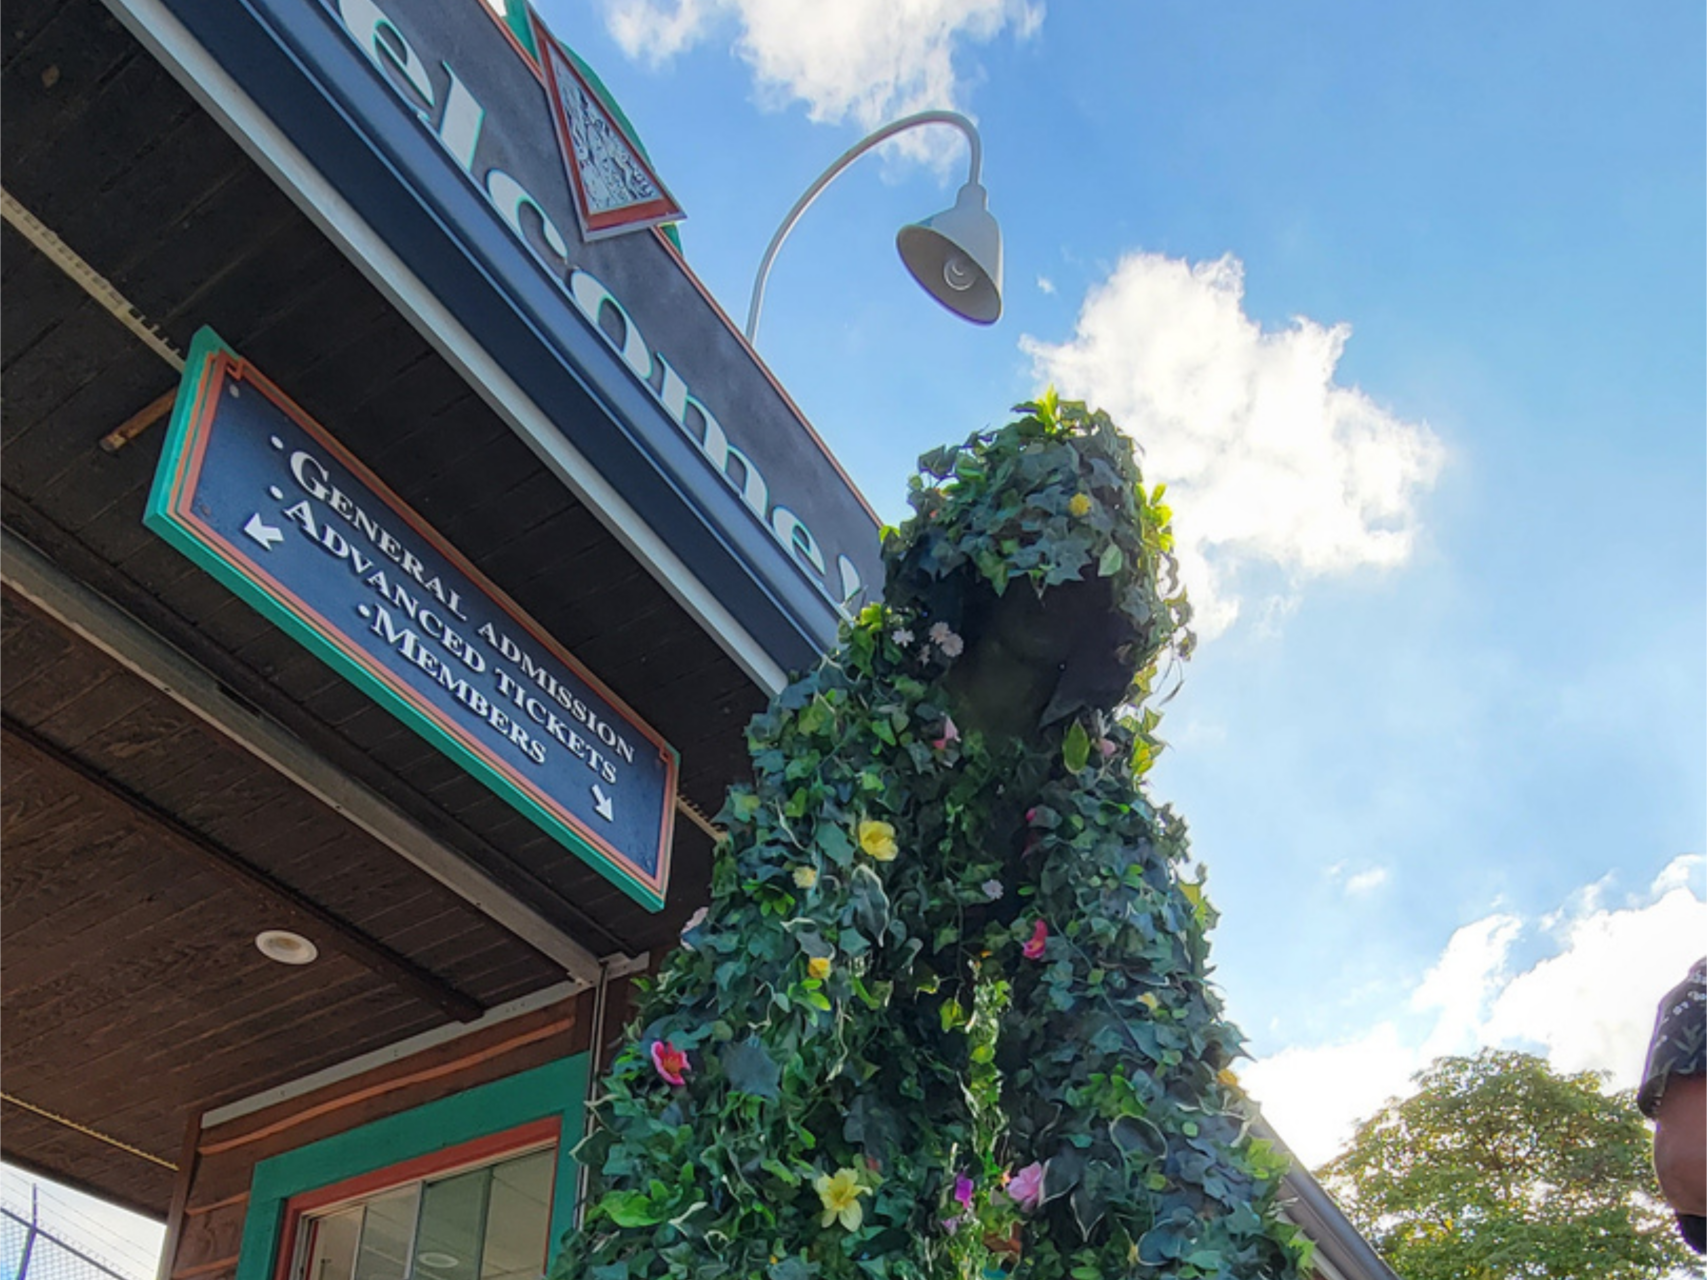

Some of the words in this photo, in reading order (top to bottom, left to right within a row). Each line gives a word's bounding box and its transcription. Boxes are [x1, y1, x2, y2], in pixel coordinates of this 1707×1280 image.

[285, 501, 487, 673] ADVANCED
[495, 668, 617, 784] TICKETS
[290, 450, 468, 621] GENERAL
[478, 622, 634, 763] ADMISSION
[371, 604, 546, 764] MEMBERS
